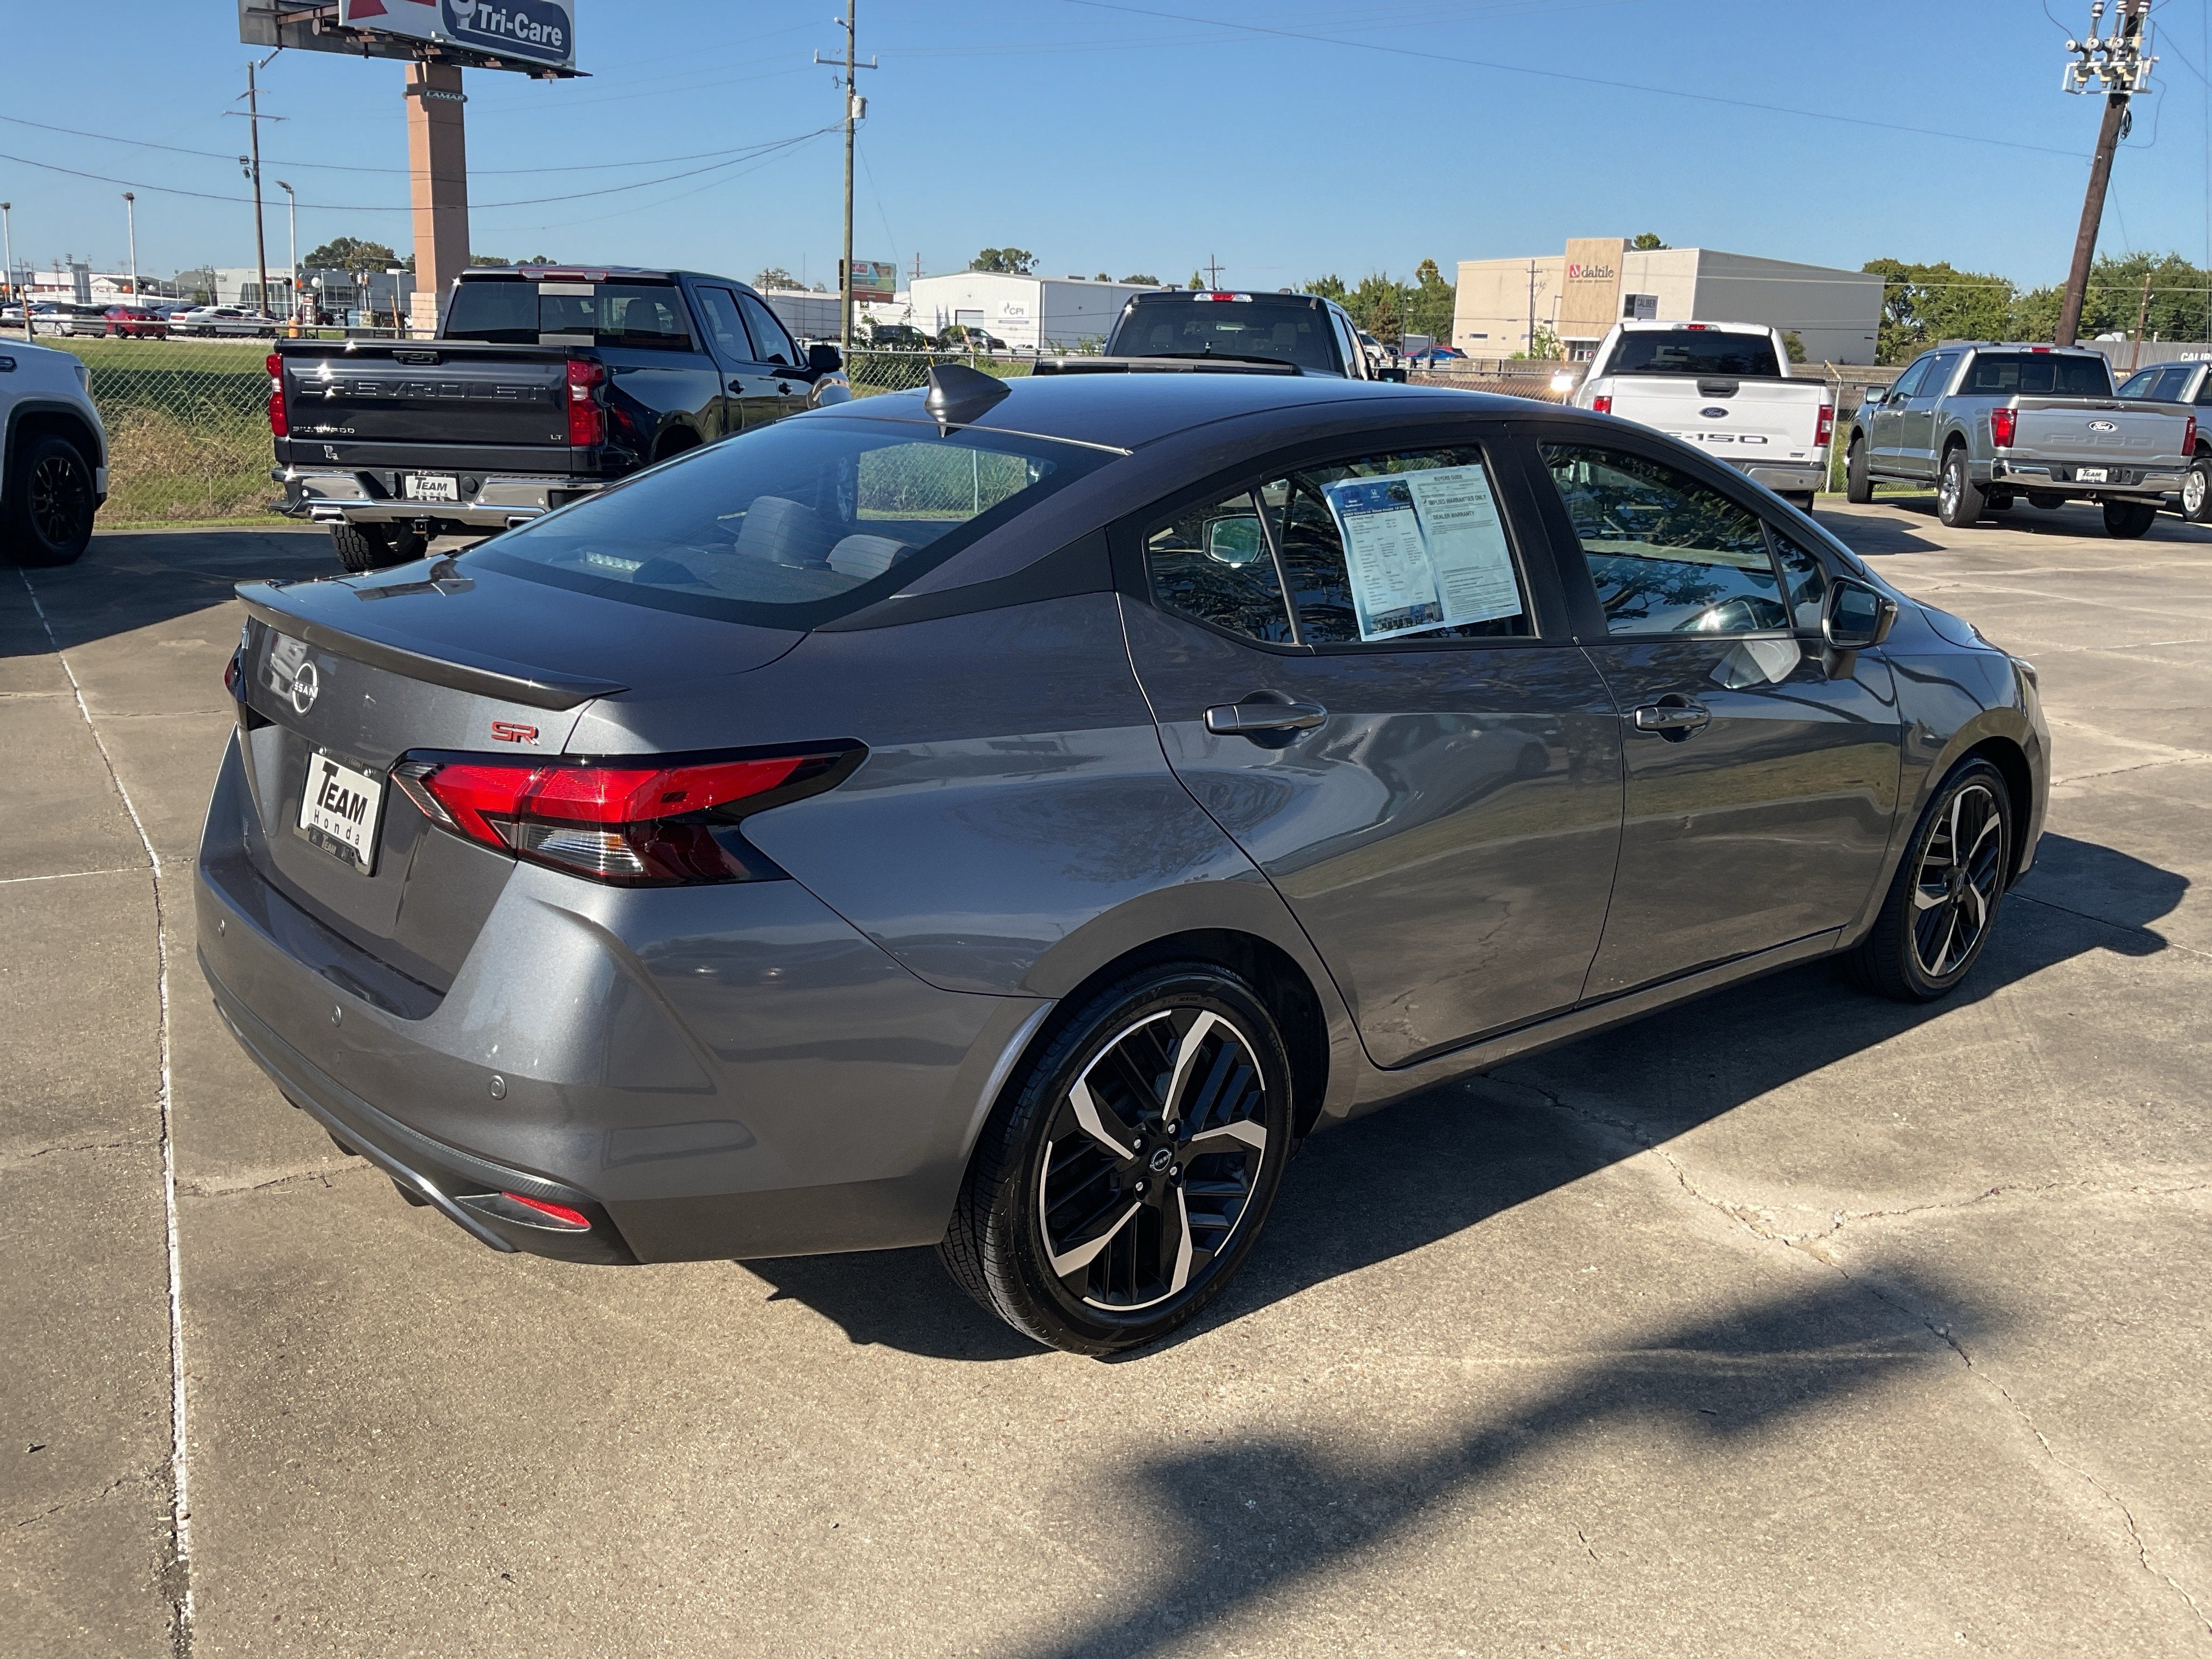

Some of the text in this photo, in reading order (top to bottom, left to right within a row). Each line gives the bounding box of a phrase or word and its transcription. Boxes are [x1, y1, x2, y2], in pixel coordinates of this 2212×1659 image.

[478, 3, 562, 46] Tri-Care
[426, 91, 464, 101] LAMAR
[1582, 264, 1615, 278] daltile
[1637, 298, 1656, 308] CALIBER
[2180, 352, 2212, 362] CALIB
[300, 379, 550, 400] CHEVROLET
[1705, 408, 1722, 417] Ford
[2094, 422, 2111, 431] Ford
[2044, 433, 2155, 448] F-150
[1446, 496, 1475, 504] WARRANTIES
[491, 721, 540, 746] SR
[314, 808, 360, 846] Honda
